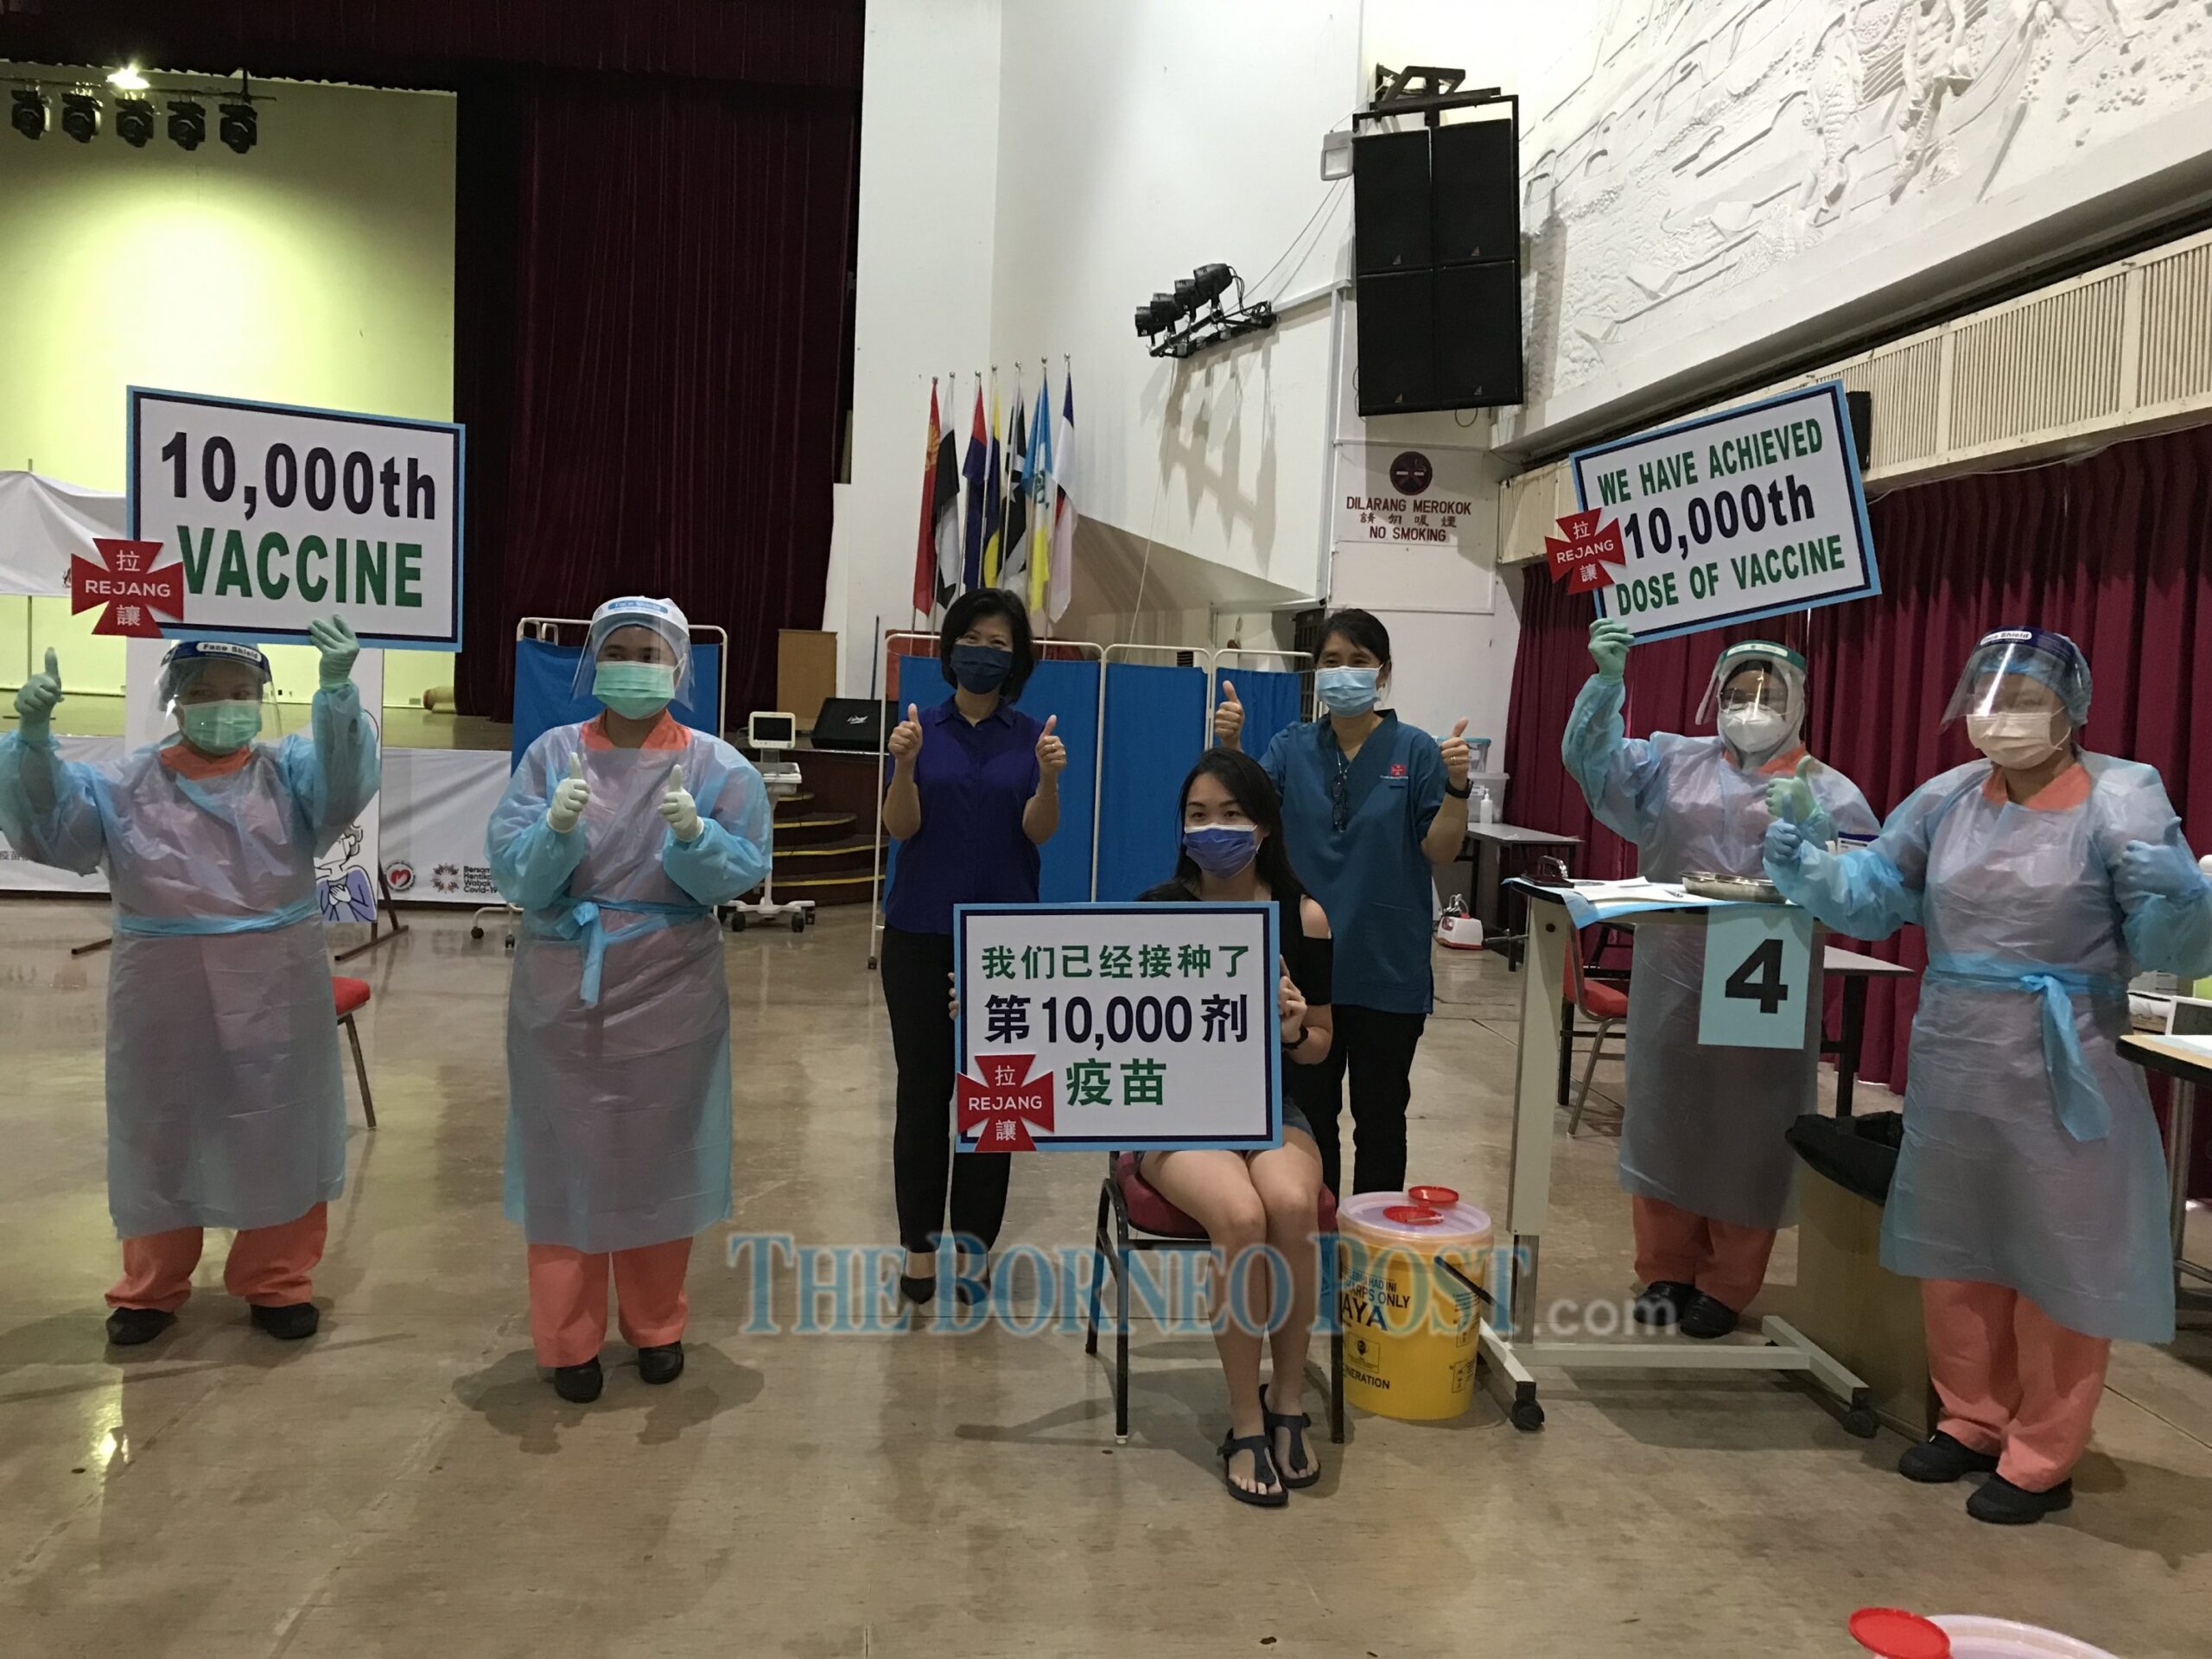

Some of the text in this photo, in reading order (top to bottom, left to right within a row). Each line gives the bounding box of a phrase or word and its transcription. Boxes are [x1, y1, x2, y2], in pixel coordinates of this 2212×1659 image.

[1597, 418, 1822, 506] WE HAVE ACHIEVED
[162, 431, 435, 520] 10,000th
[1346, 496, 1471, 515] DILARANG MEROKOK
[1624, 474, 1815, 560] 10,000th
[1370, 526, 1446, 542] NO SMOKING
[1573, 520, 1590, 539] 拉
[116, 550, 140, 572] 拉
[1556, 539, 1614, 563] REJANG
[177, 524, 423, 607] VACCINE
[1616, 535, 1845, 616] DOSE OF VACCINE
[85, 579, 171, 597] REJANG
[982, 944, 1249, 979] 我们已经接种了
[1725, 938, 1789, 1014] 4
[995, 1065, 1015, 1086] 拉
[1065, 1058, 1166, 1106] 疫苗
[969, 1096, 1042, 1111] REJANG
[1378, 1291, 1410, 1309] ONLY
